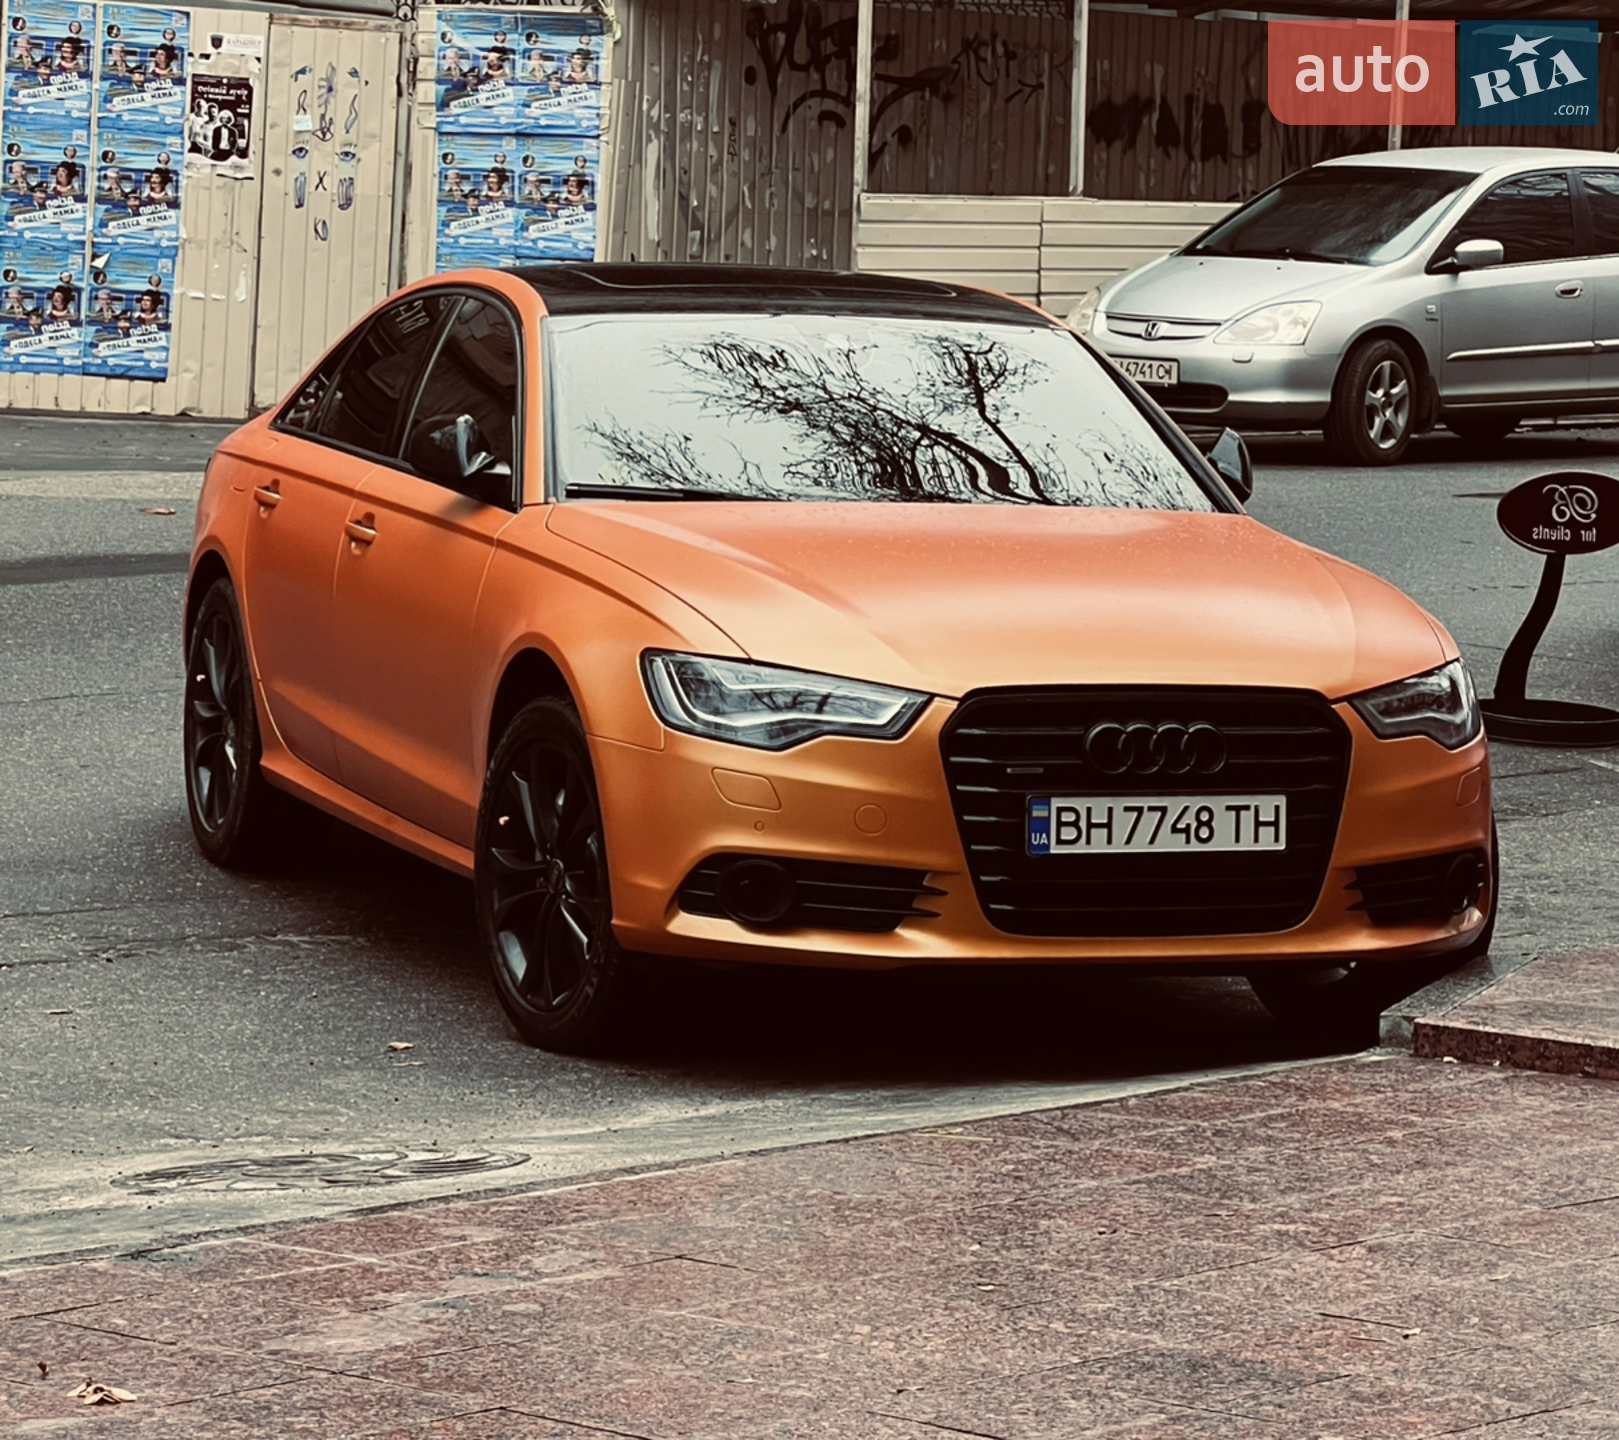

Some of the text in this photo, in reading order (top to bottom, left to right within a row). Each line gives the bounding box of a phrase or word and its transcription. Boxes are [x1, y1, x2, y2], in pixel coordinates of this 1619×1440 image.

[1031, 832, 1049, 845] UA
[1055, 804, 1281, 846] BH 7748 TH
